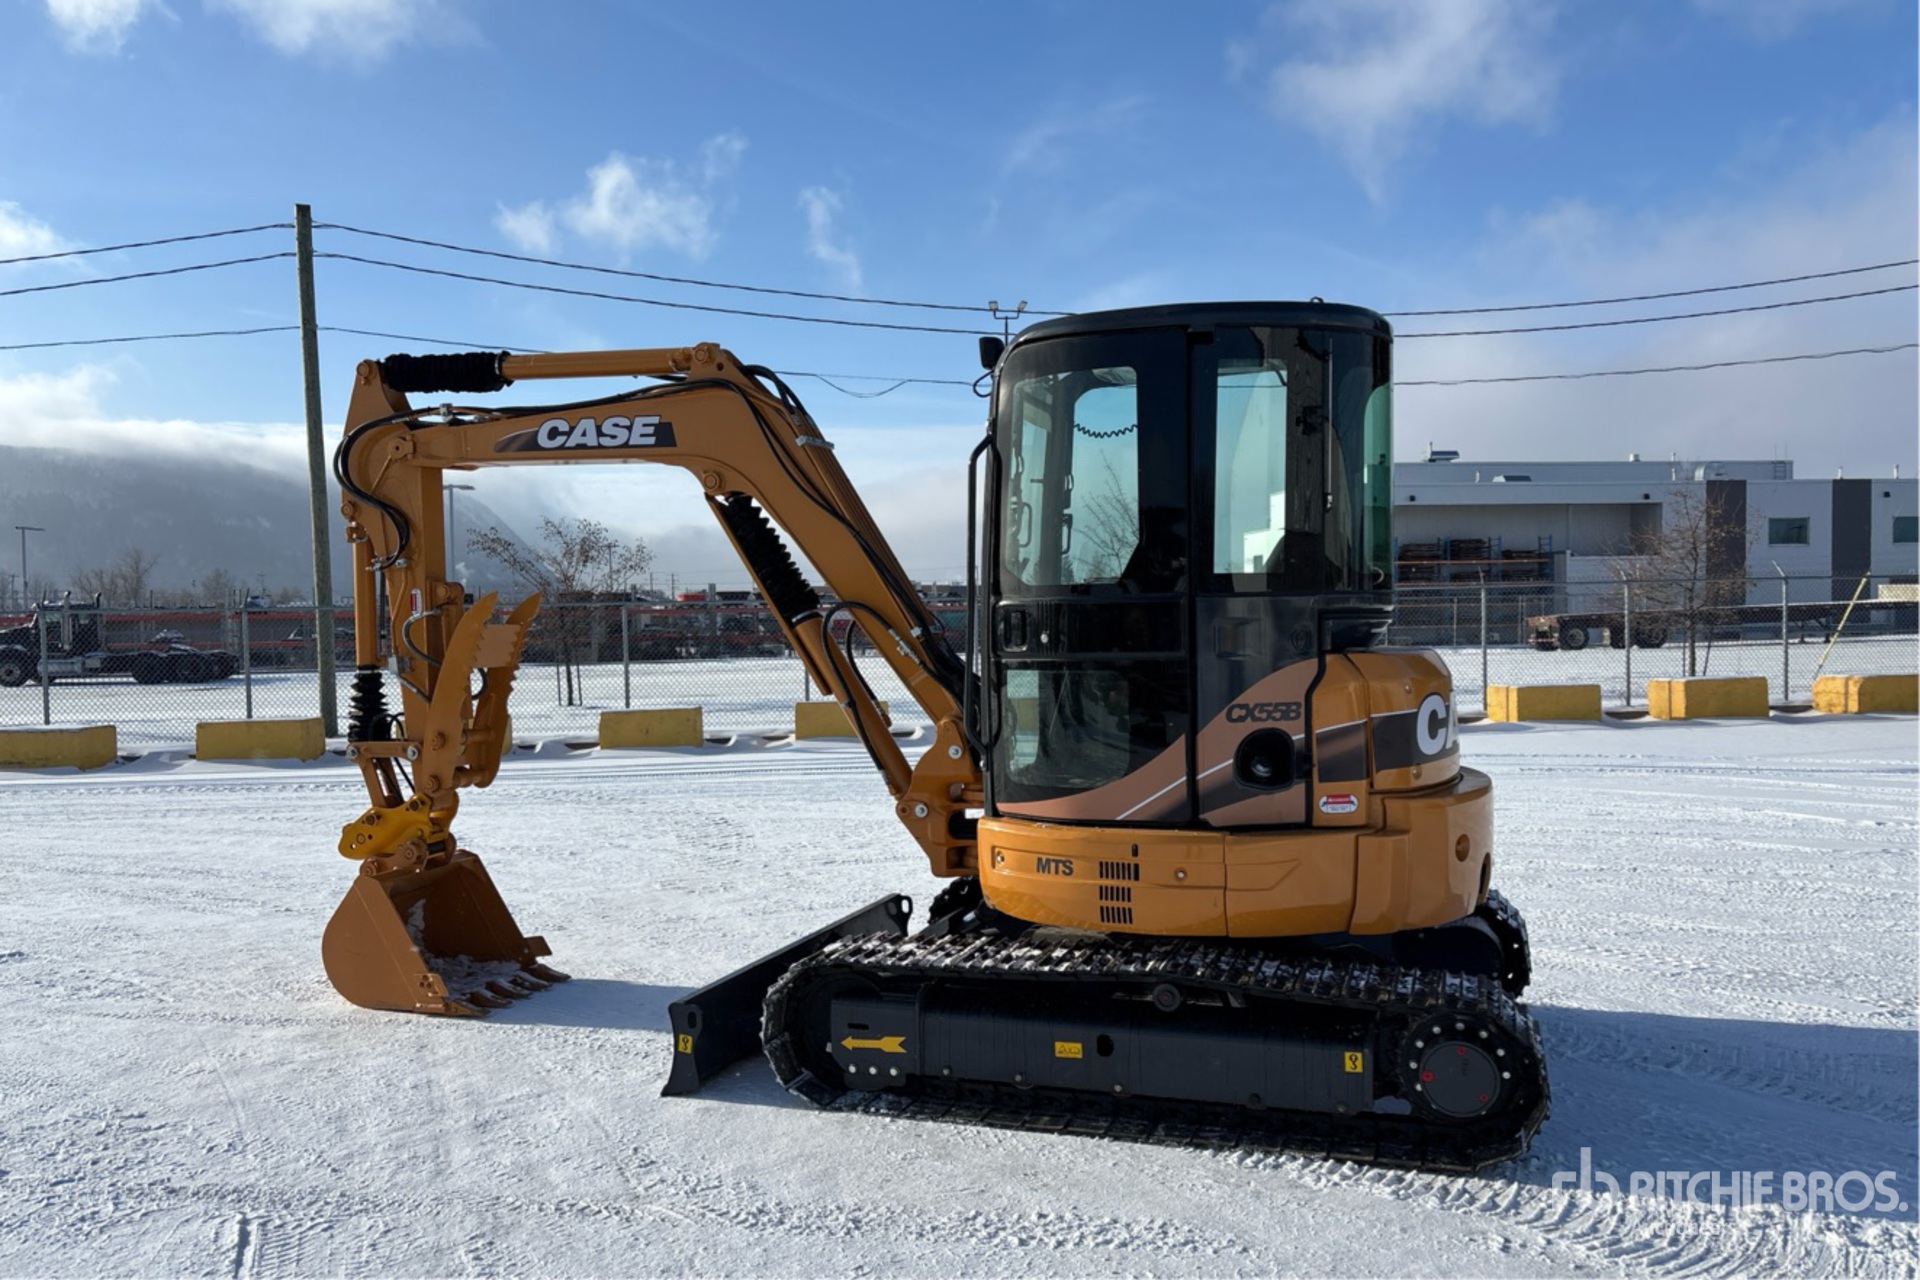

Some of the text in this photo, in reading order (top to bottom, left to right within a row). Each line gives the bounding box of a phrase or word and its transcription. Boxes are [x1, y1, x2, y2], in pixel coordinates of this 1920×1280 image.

[537, 416, 660, 448] CASE
[1226, 702, 1302, 723] CX55B
[1036, 857, 1074, 876] MTS
